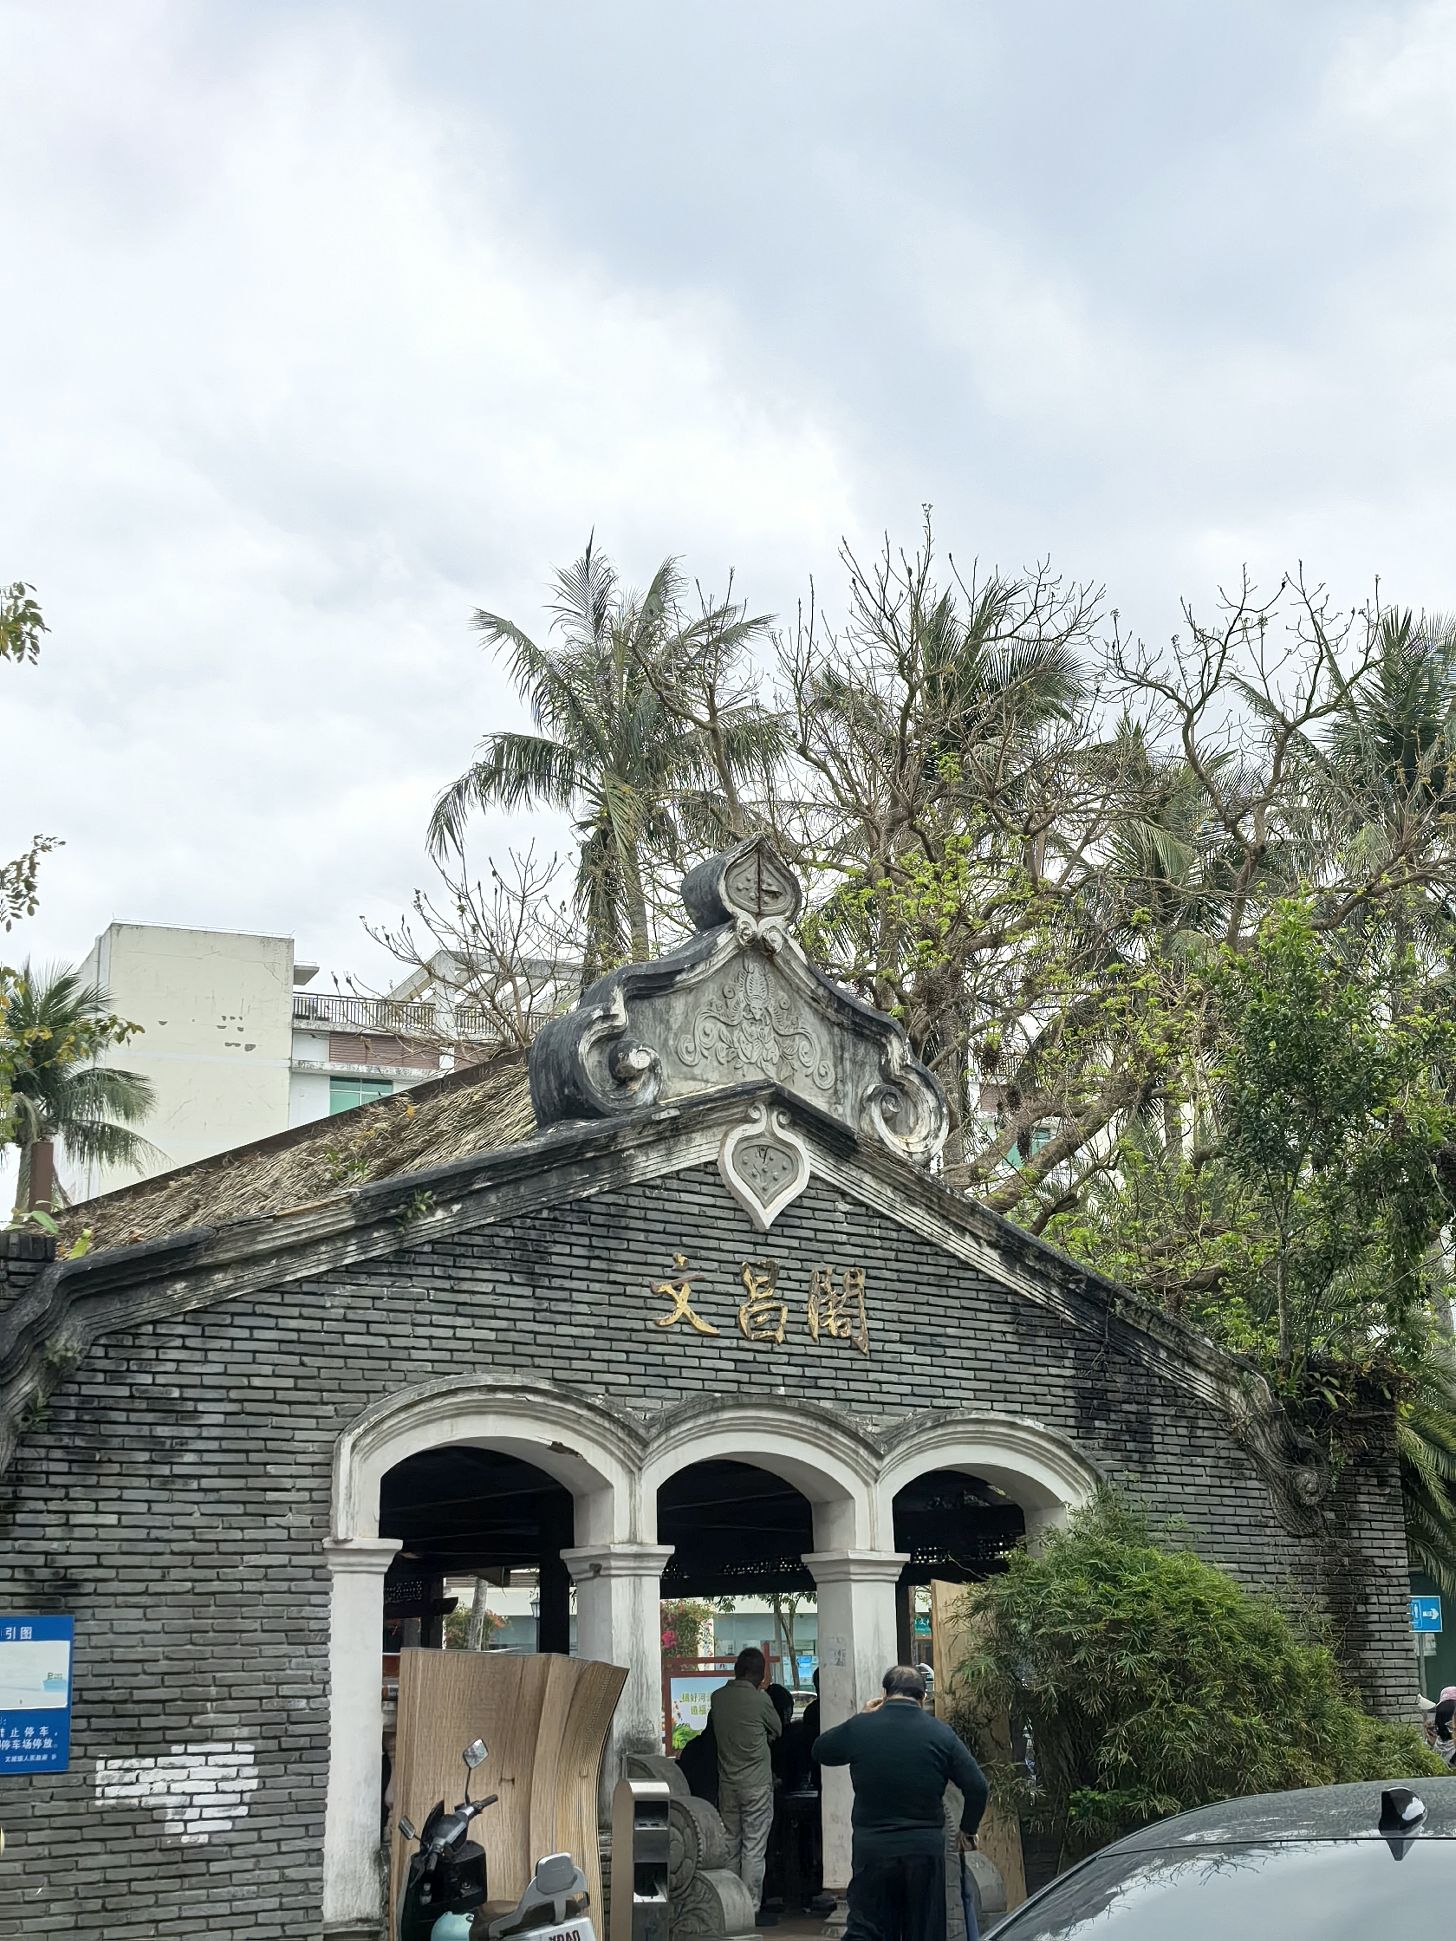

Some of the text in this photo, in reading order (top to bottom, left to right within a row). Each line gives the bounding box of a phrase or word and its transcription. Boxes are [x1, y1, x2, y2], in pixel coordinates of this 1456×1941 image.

[0, 1626, 33, 1640] 引图
[0, 1737, 58, 1750] 停车场停放。
